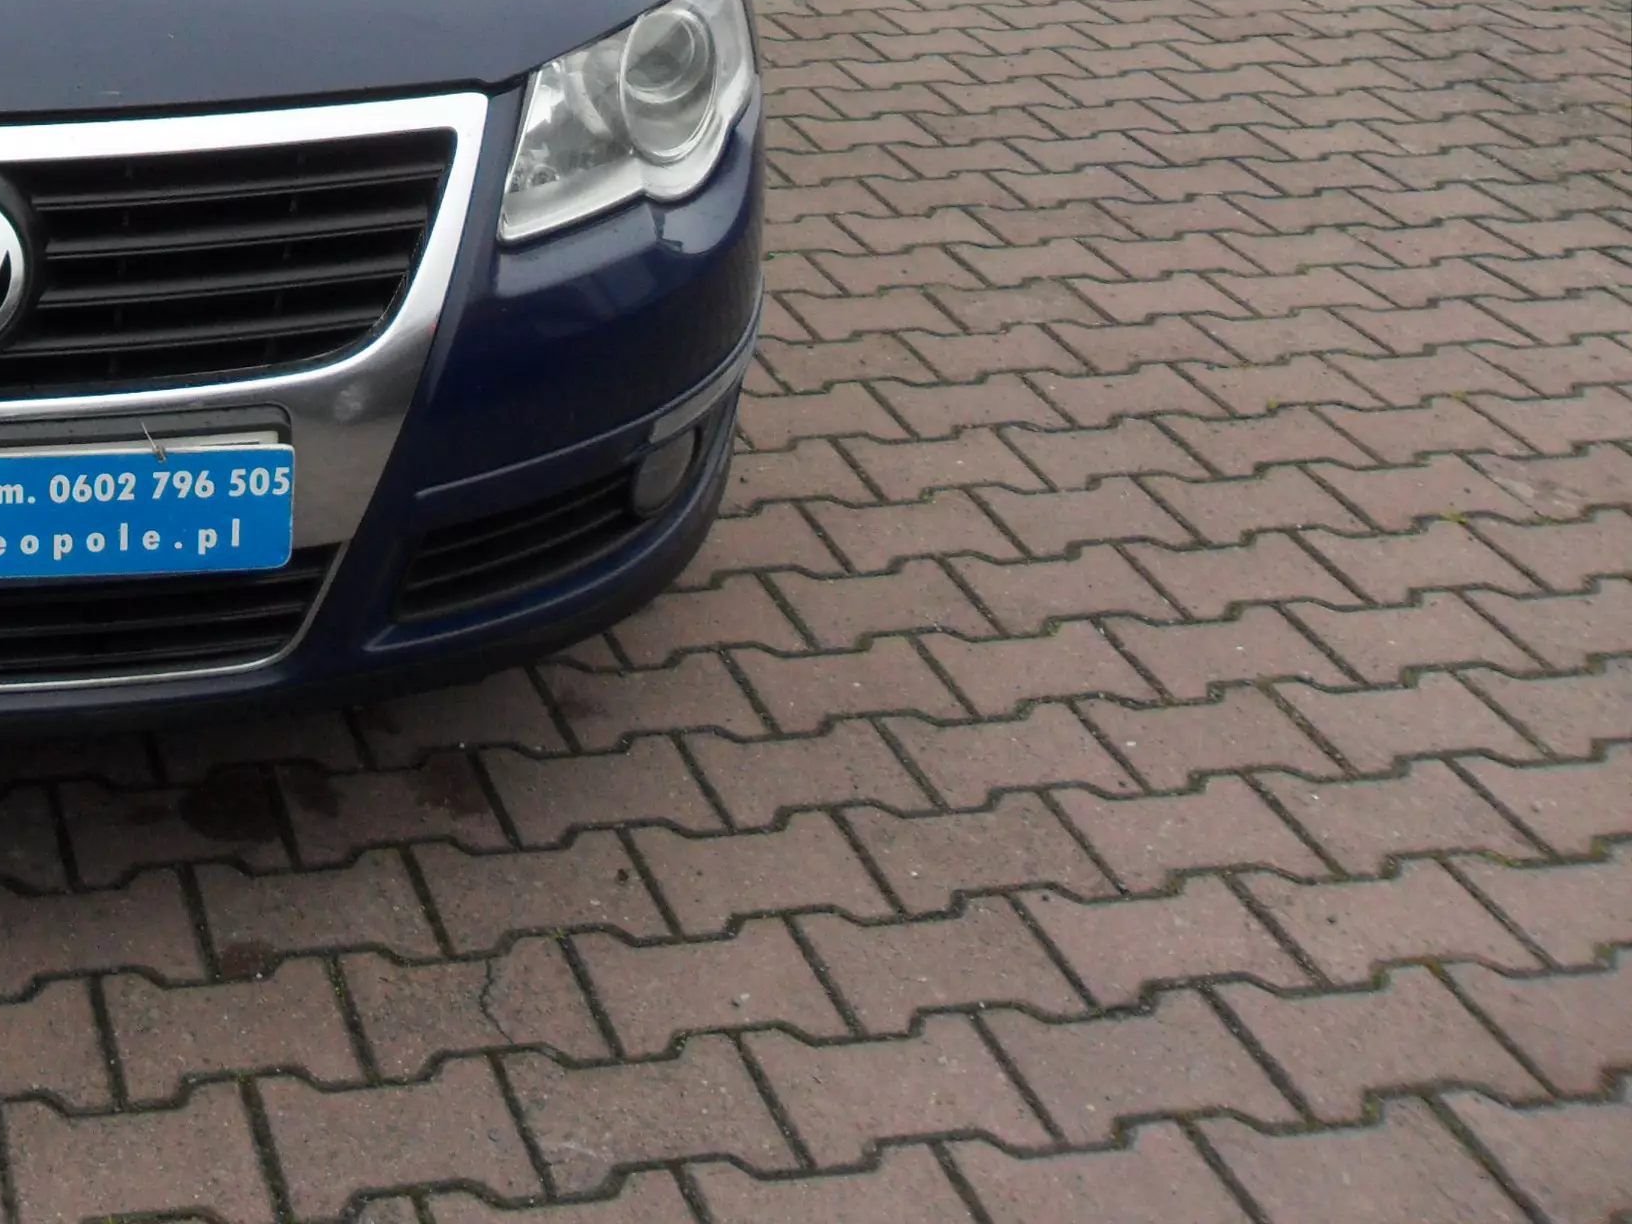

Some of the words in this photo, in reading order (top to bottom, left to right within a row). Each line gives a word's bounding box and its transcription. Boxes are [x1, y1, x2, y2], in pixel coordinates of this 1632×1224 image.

[49, 473, 136, 503] 0602
[152, 470, 215, 500] 796
[229, 467, 291, 498] 505
